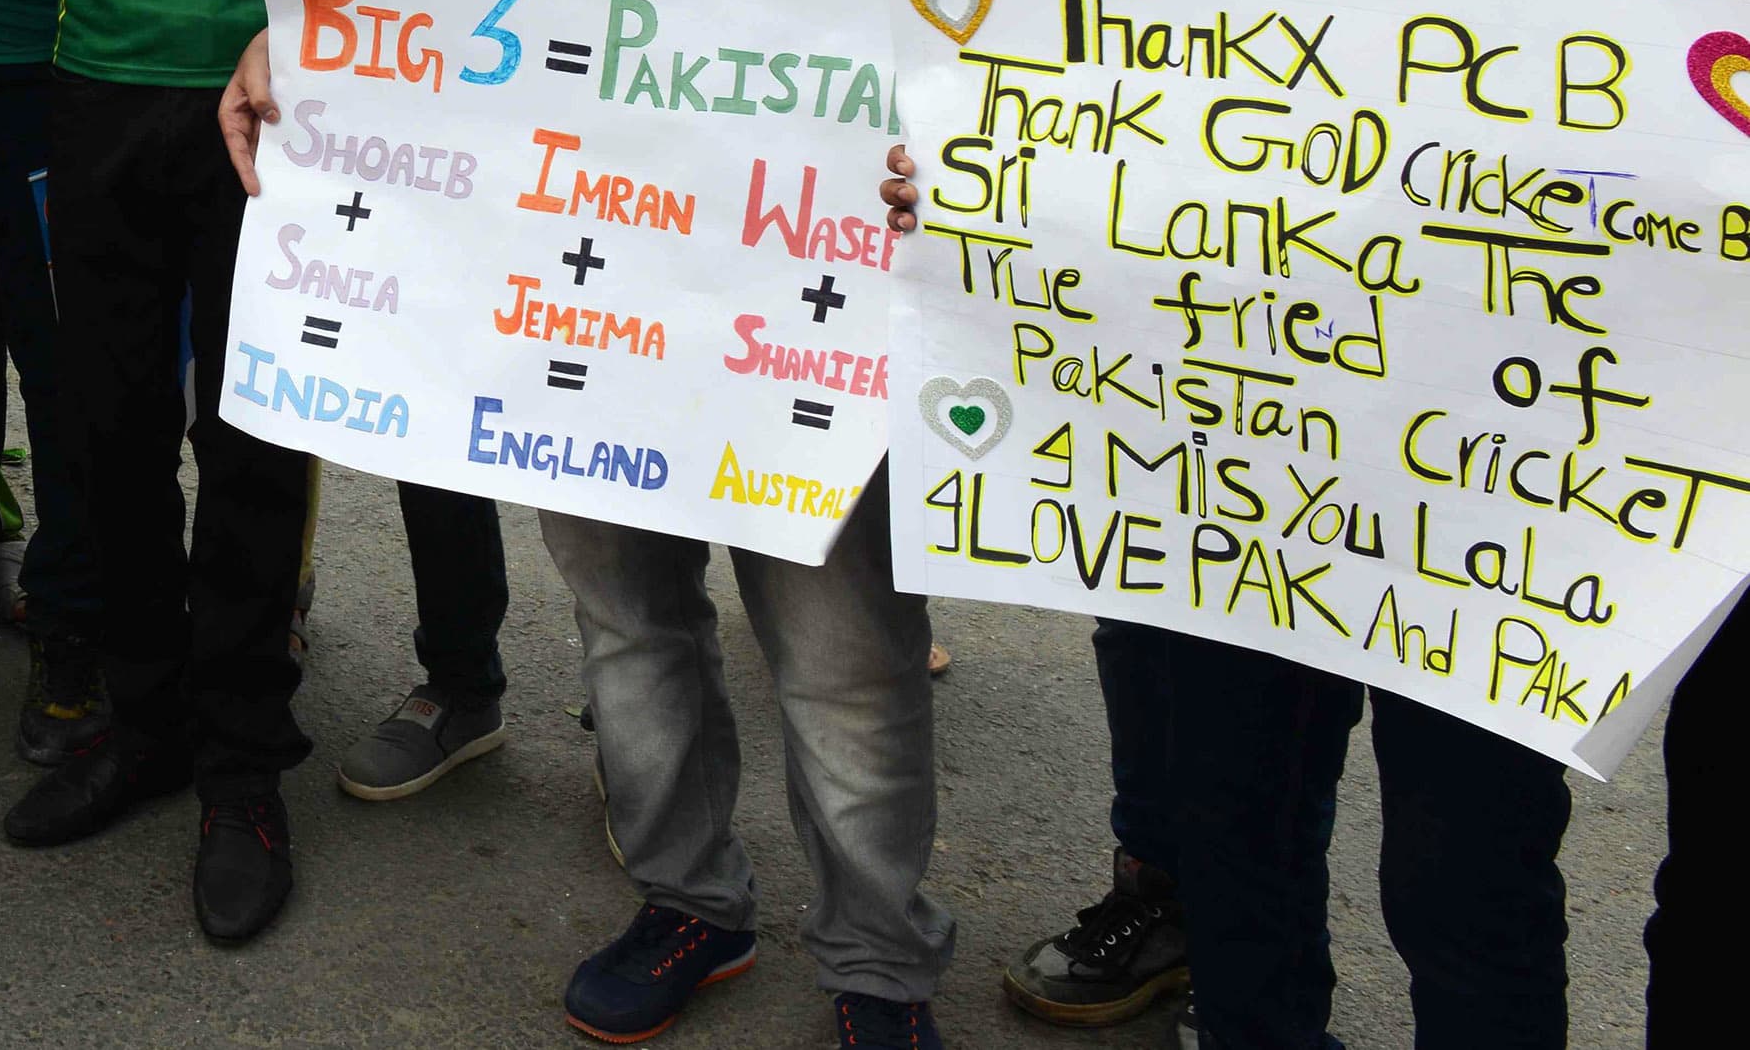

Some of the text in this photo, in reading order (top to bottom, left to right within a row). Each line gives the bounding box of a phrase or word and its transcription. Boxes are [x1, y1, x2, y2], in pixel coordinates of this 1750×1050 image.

[281, 99, 479, 200] SHOAIB
[516, 128, 696, 235] IMRAN
[932, 137, 1038, 230] Sri
[1421, 225, 1611, 336] The
[1721, 202, 1750, 262] B
[265, 222, 400, 315] SANIA
[493, 273, 666, 361] JEMIMA
[923, 224, 1096, 323] True
[1492, 346, 1650, 446] of
[232, 341, 410, 439] INDIA
[467, 395, 669, 491] ENGLAND
[968, 471, 1170, 593] LOVE
[1190, 523, 1352, 640] PAK
[1364, 582, 1458, 678] And
[1489, 616, 1590, 725] PAK
[1105, 430, 1269, 524] Mis
[1283, 463, 1385, 560] You
[1417, 500, 1616, 626] LaLa
